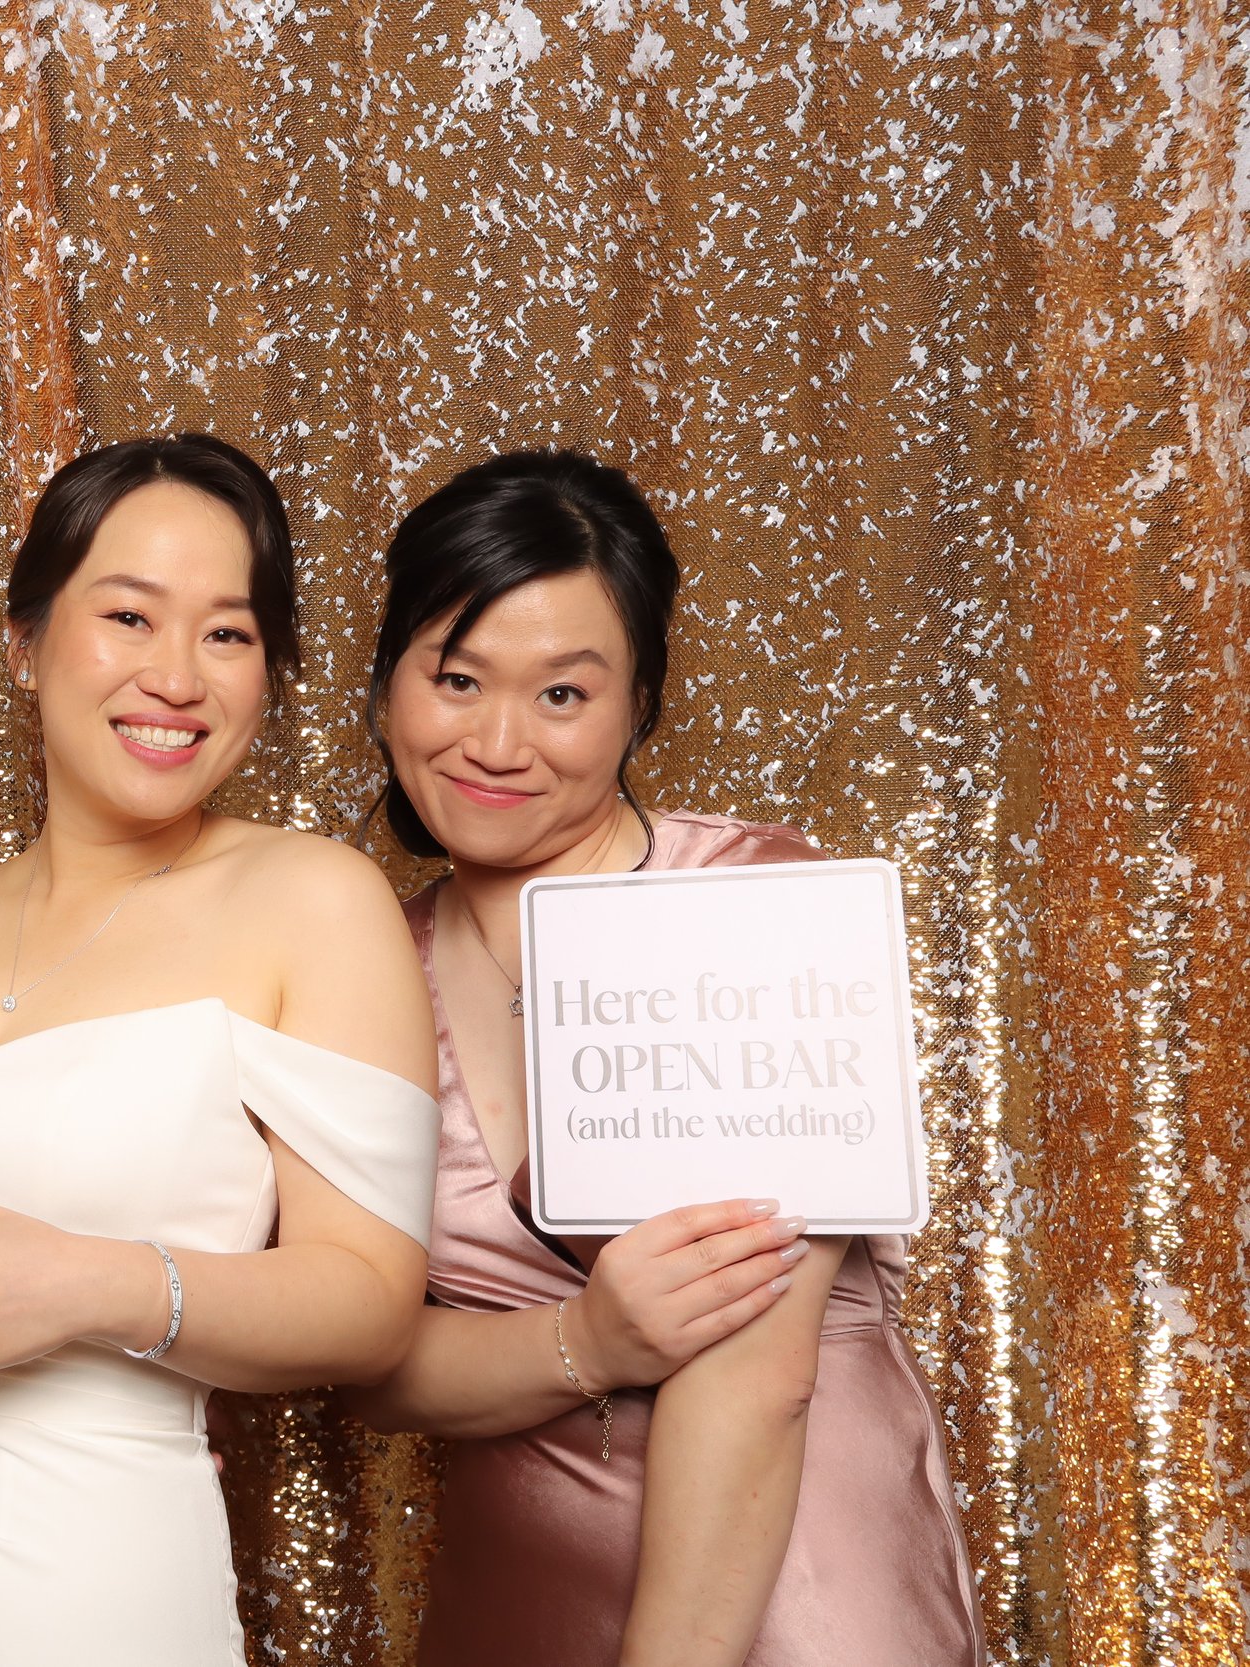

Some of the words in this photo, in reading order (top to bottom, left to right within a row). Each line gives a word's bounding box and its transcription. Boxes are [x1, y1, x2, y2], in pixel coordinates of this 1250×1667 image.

[553, 979, 677, 1027] Here
[694, 972, 770, 1022] for
[789, 968, 878, 1019] the
[571, 1042, 722, 1093] OPEN
[740, 1038, 867, 1089] BAR
[567, 1106, 641, 1144] (and
[652, 1107, 704, 1139] the
[715, 1099, 876, 1145] wedding)
